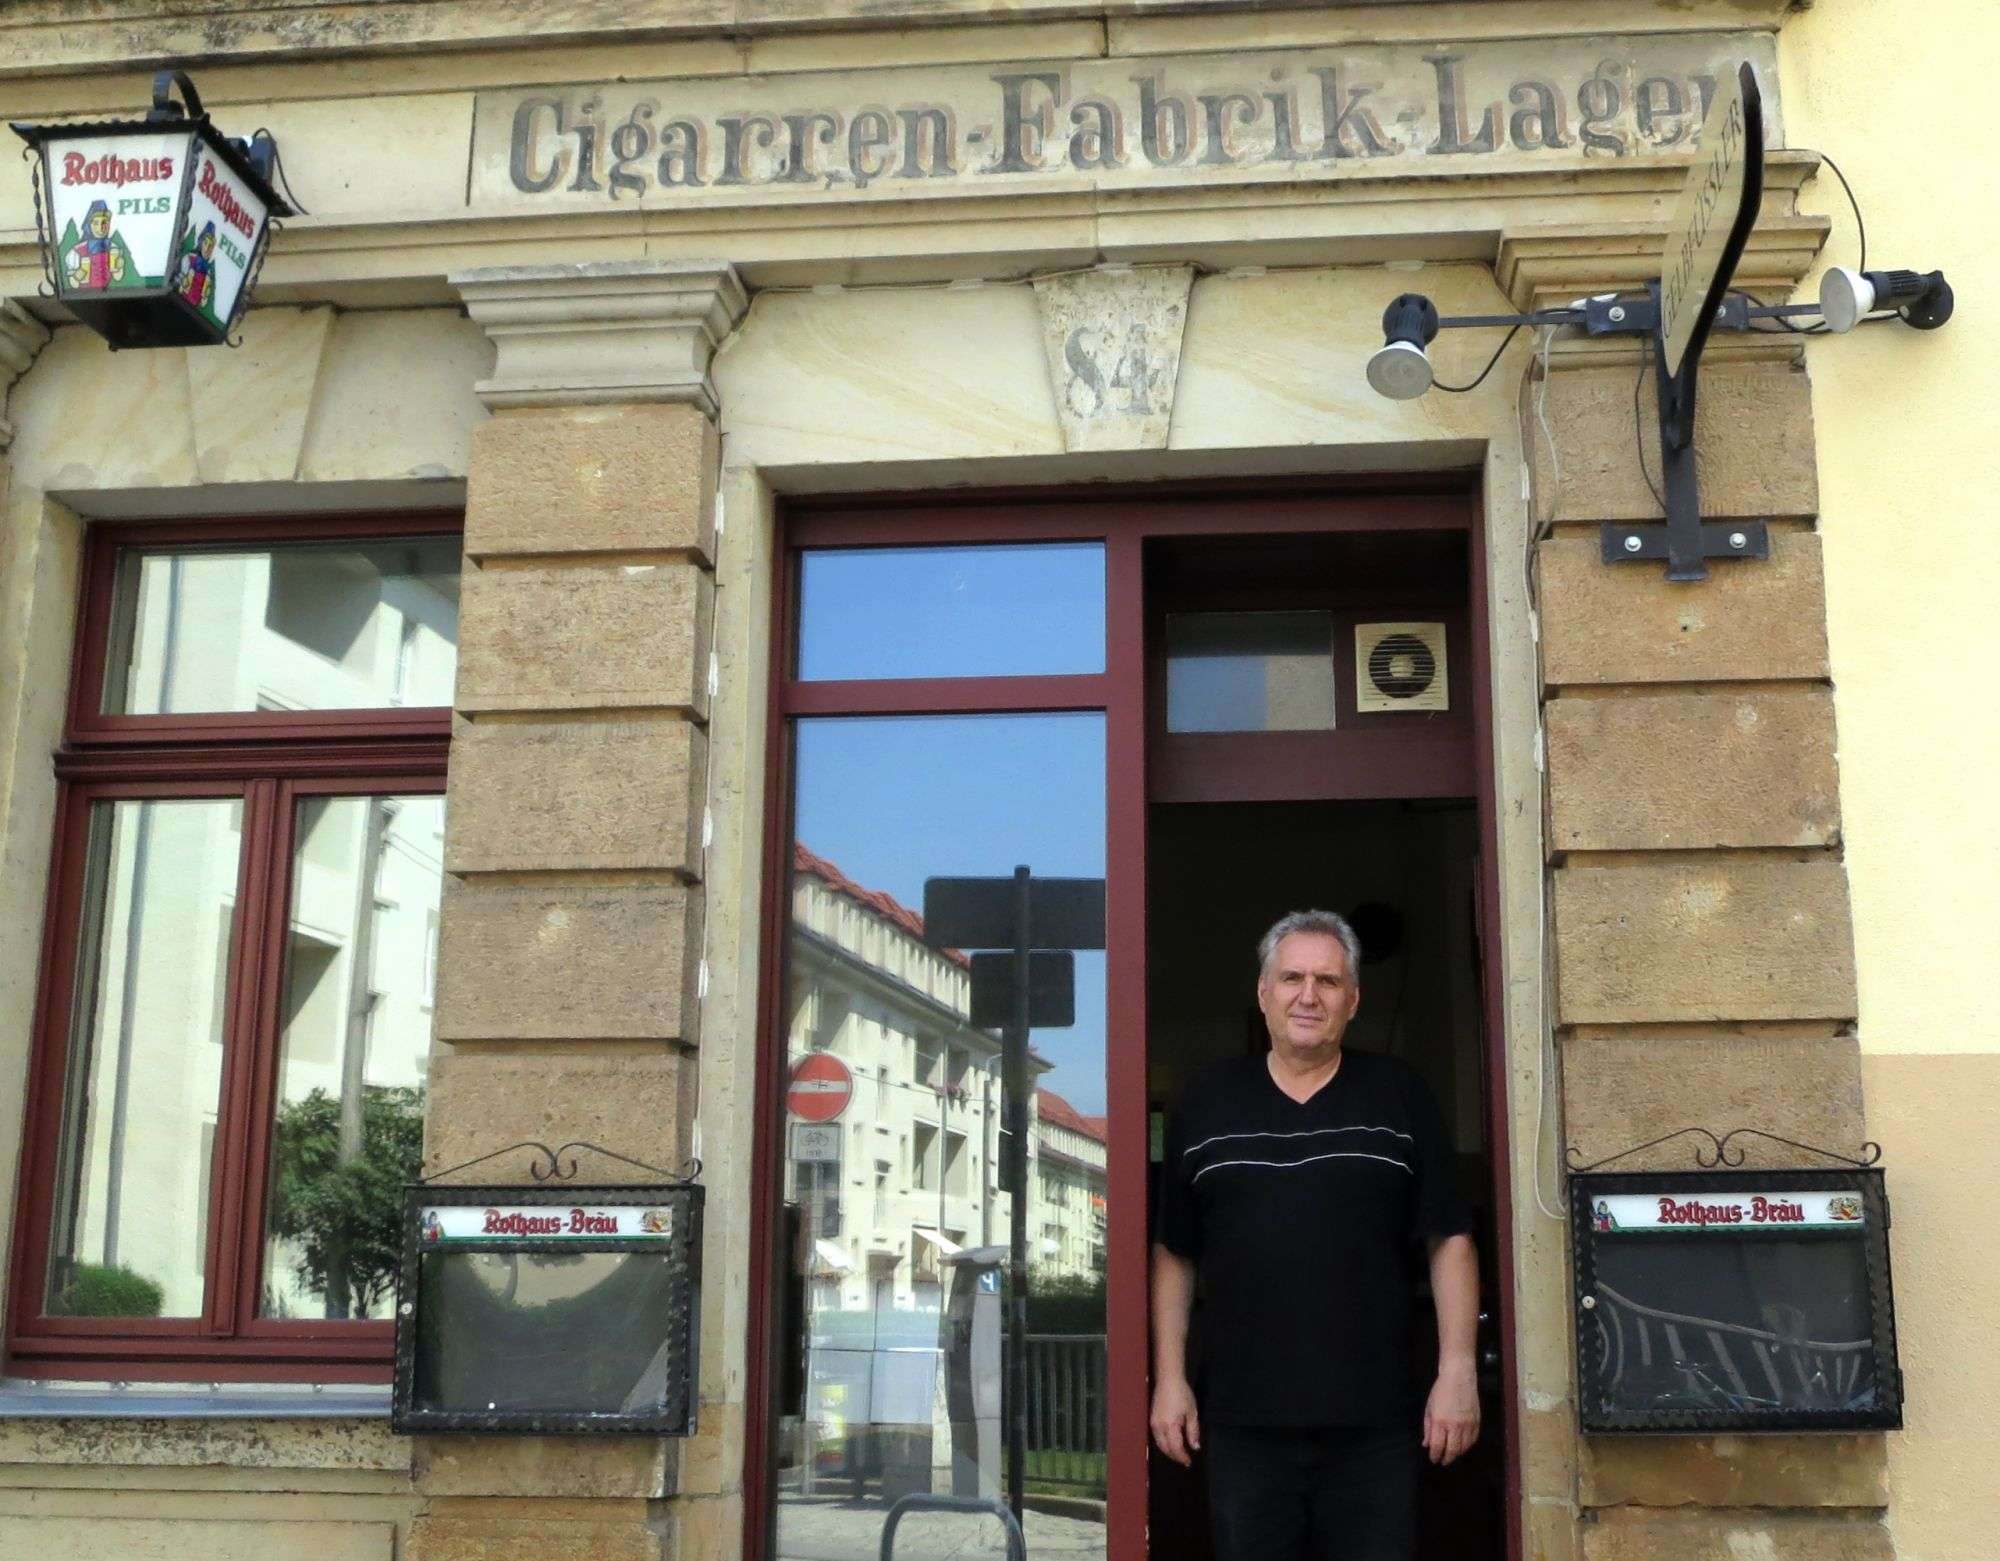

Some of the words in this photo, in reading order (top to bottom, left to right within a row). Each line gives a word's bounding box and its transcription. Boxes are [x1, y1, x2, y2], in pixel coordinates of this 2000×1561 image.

[61, 152, 174, 188] Rothaus
[117, 197, 171, 216] PILS
[199, 160, 255, 238] Rothaus
[218, 233, 247, 270] PILS
[482, 1208, 618, 1236] Rothaus-Bräu
[1657, 1196, 1805, 1226] Rothaus-Bräu
